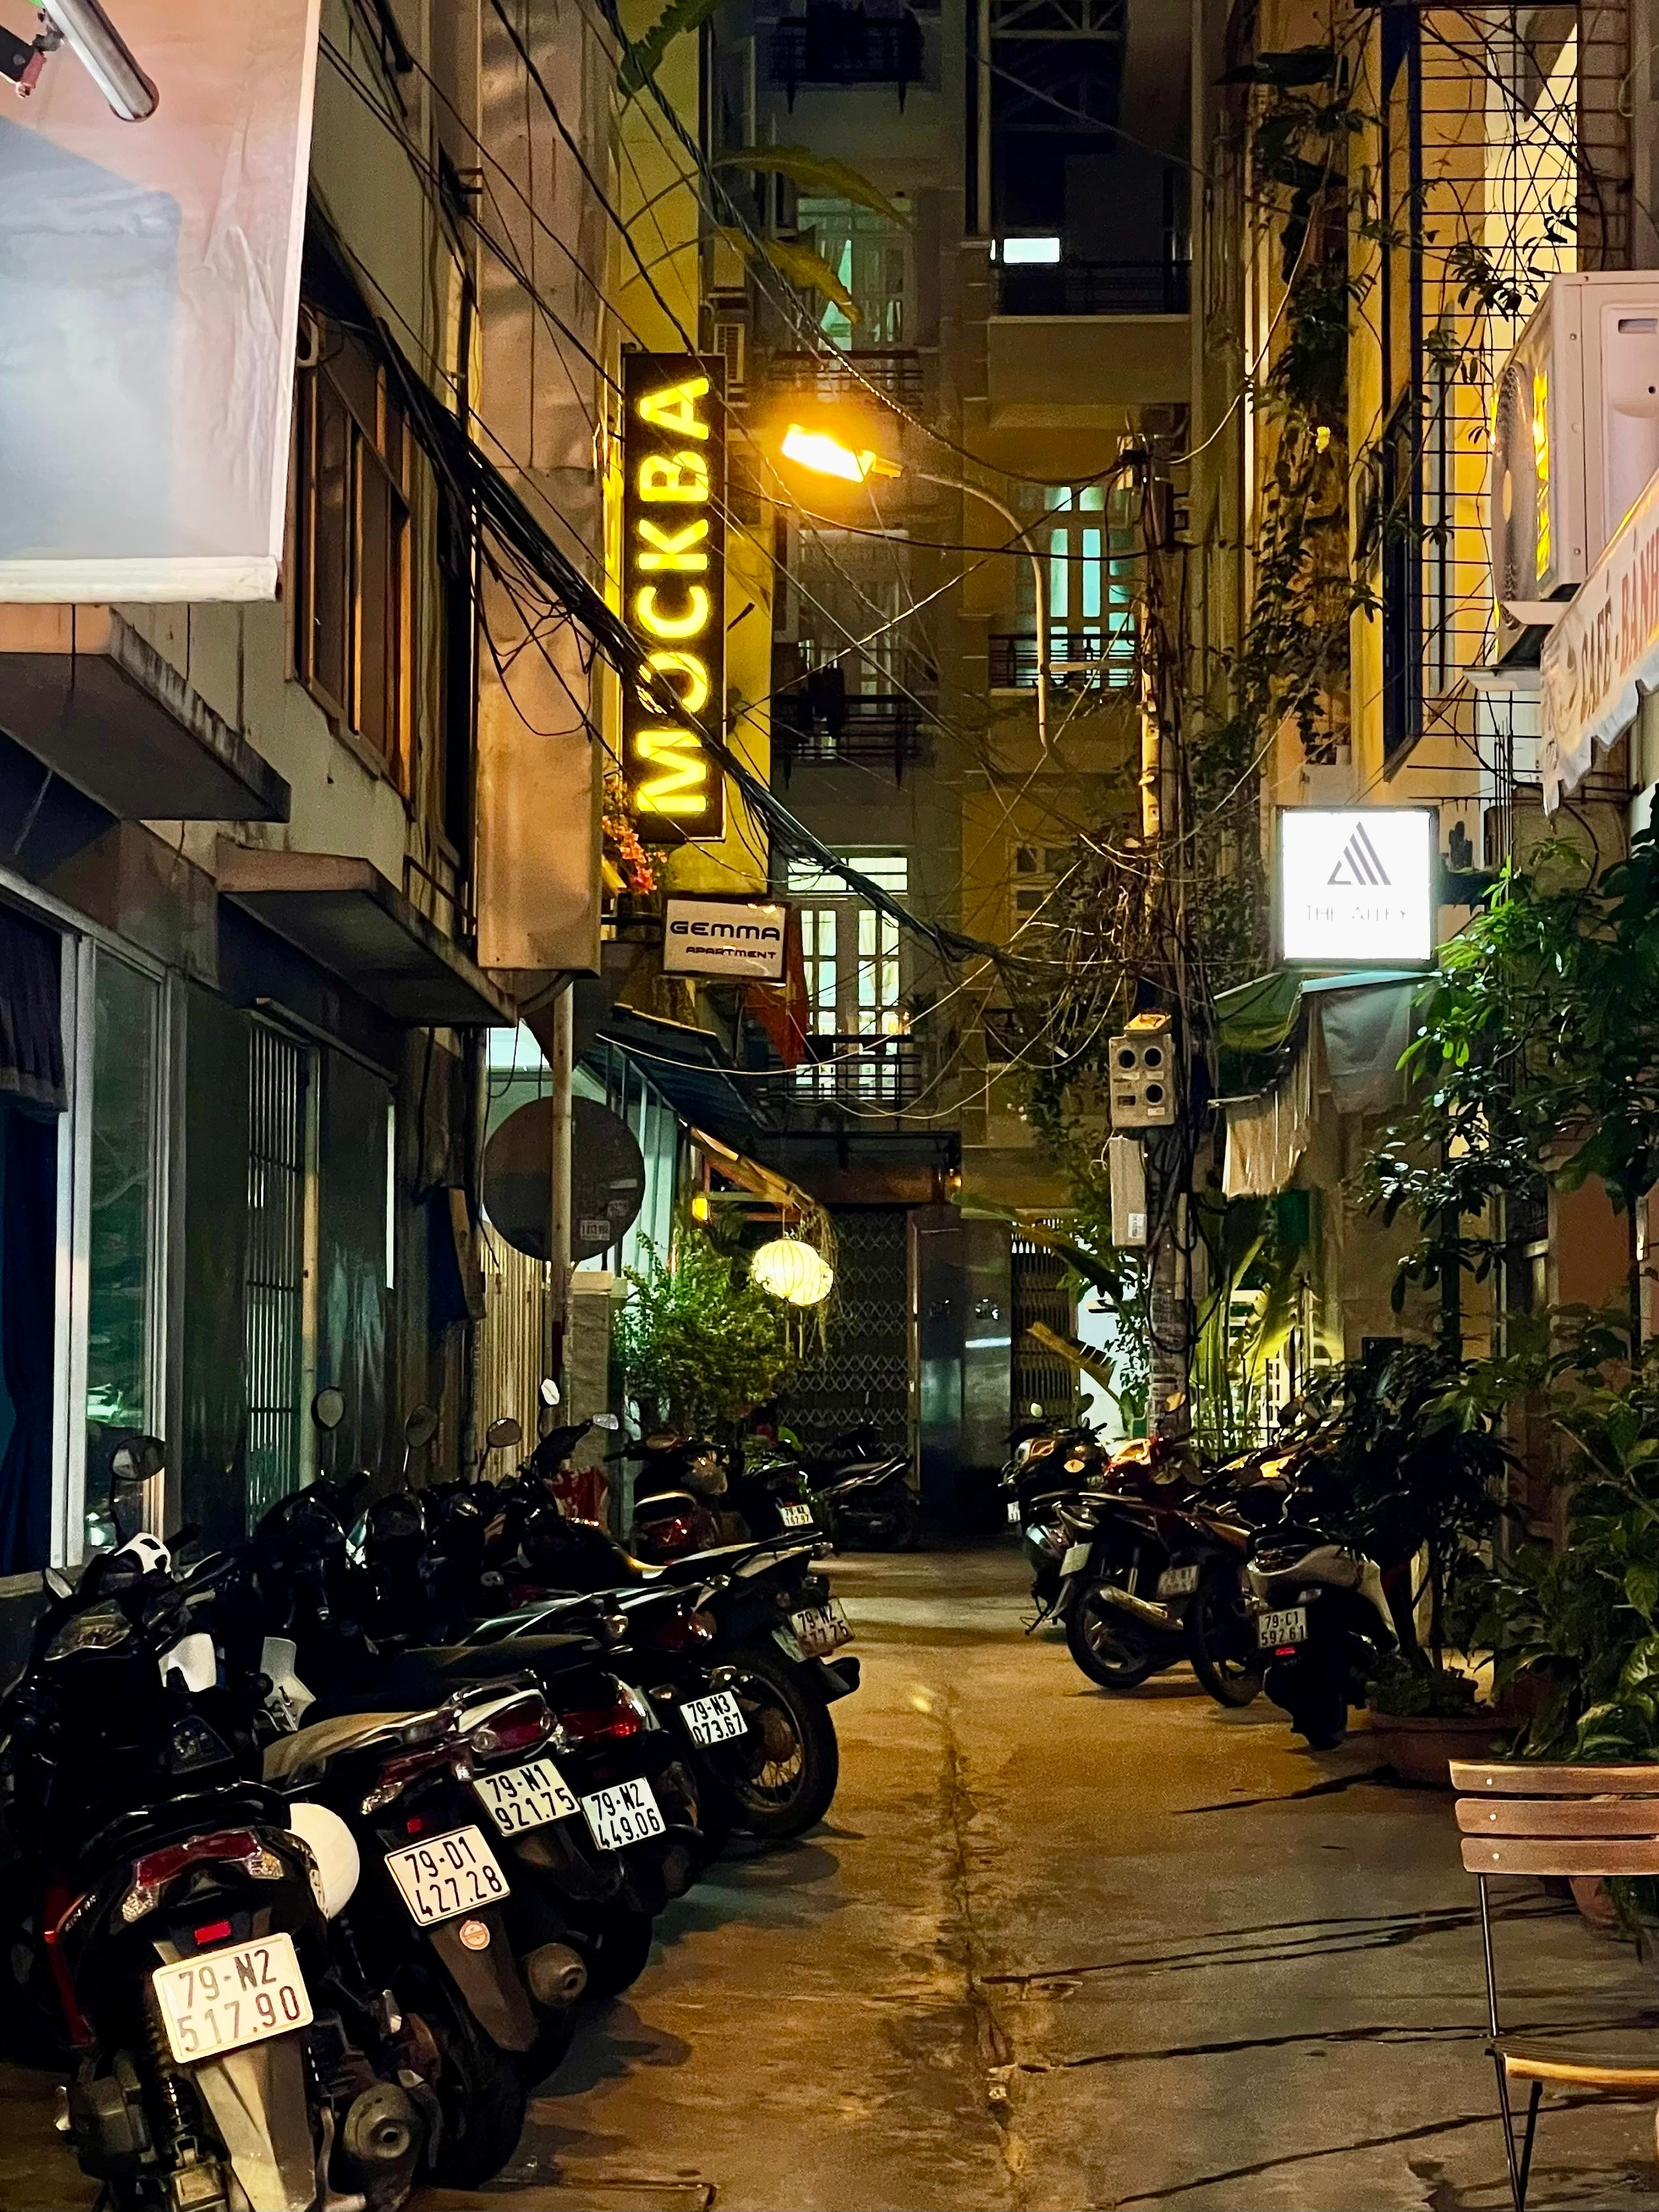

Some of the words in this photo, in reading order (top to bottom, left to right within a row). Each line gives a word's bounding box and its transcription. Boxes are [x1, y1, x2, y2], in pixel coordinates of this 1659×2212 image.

[670, 921, 781, 941] GEMMA
[686, 946, 777, 959] APARTMENT
[686, 1700, 732, 1724] 79-N3
[692, 1714, 744, 1744] 073.67
[485, 1764, 551, 1802] 79-N1
[591, 1782, 645, 1821] 79-N2
[494, 1787, 575, 1831] 921.75
[598, 1809, 660, 1848] 449.06
[404, 1836, 477, 1883] 79-D1
[415, 1865, 503, 1917] 427.28
[178, 1949, 278, 2010] 79-N2
[177, 1985, 300, 2051] 517.90
